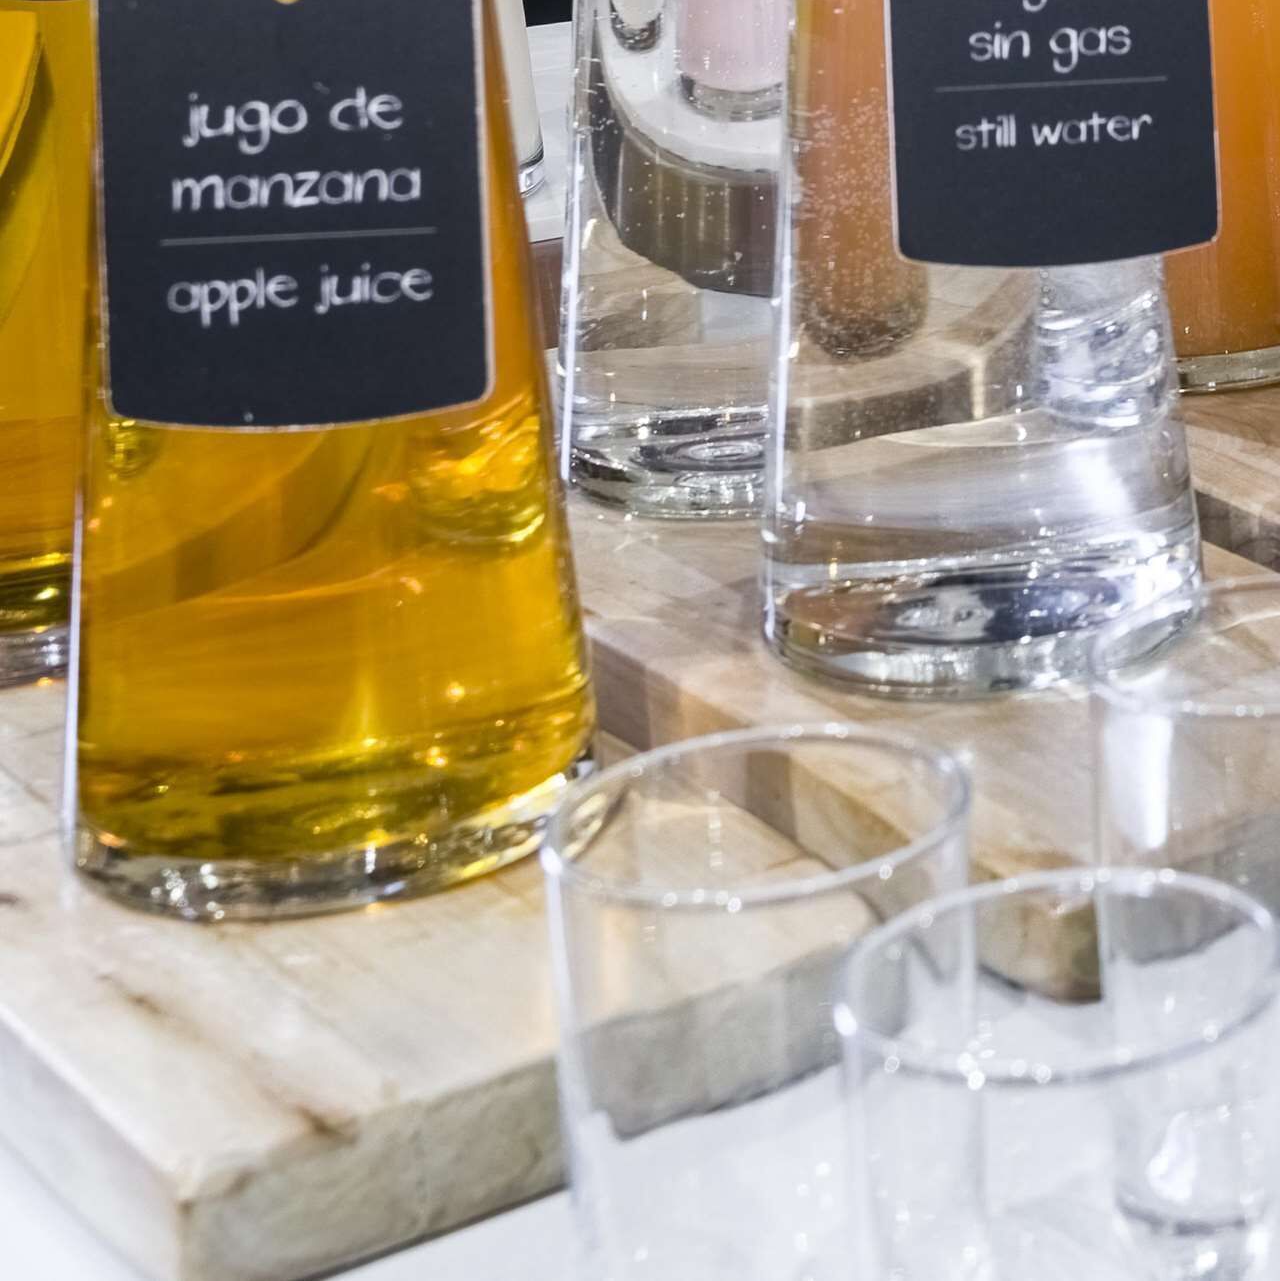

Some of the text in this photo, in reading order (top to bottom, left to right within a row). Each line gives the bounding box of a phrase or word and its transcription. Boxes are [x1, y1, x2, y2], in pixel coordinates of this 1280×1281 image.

[968, 21, 1133, 74] sin gas
[182, 86, 404, 155] jugo de
[955, 112, 1153, 150] still water
[171, 167, 423, 212] manzana
[167, 262, 434, 327] apple juice
